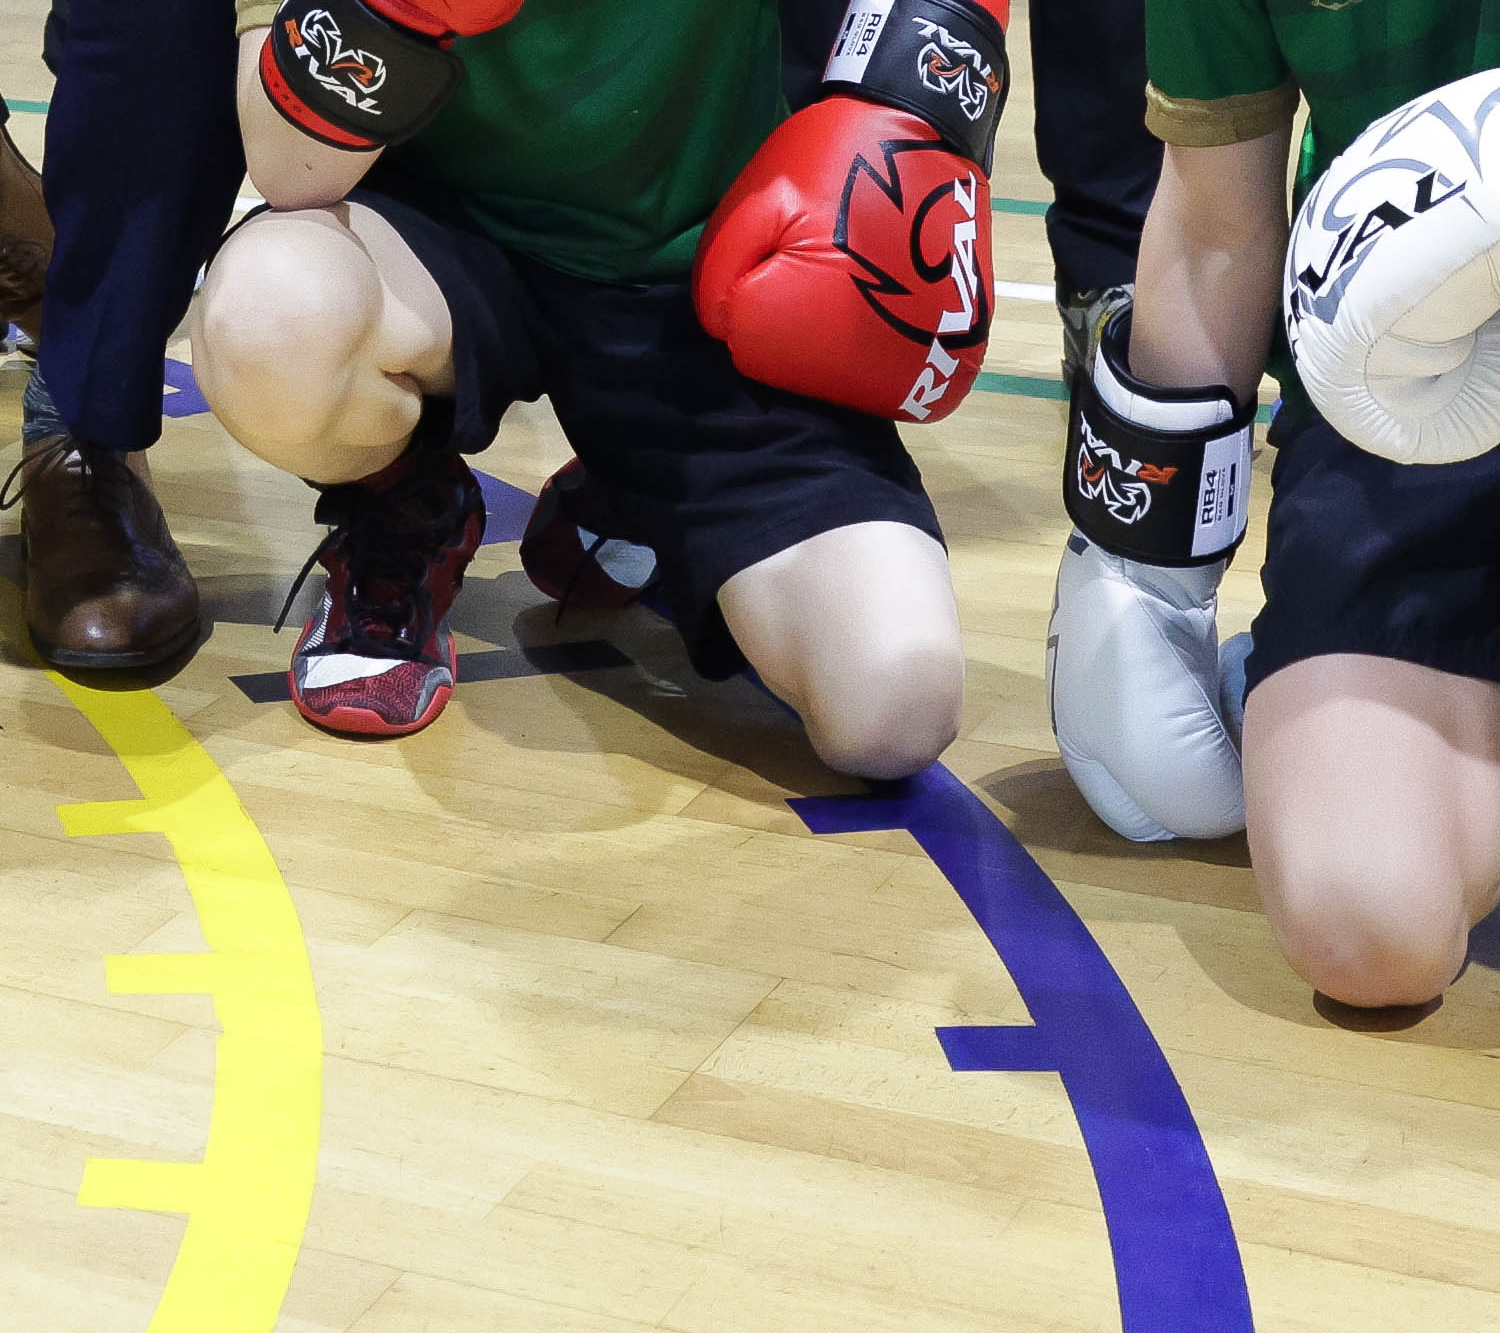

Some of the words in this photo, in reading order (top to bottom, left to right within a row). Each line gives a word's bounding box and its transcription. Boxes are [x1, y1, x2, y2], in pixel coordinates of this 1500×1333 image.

[284, 17, 383, 116] RIVAL
[856, 12, 884, 58] RB4
[912, 16, 1000, 94] RIVAL
[898, 169, 978, 422] RIVAL
[1201, 469, 1218, 529] RB4
